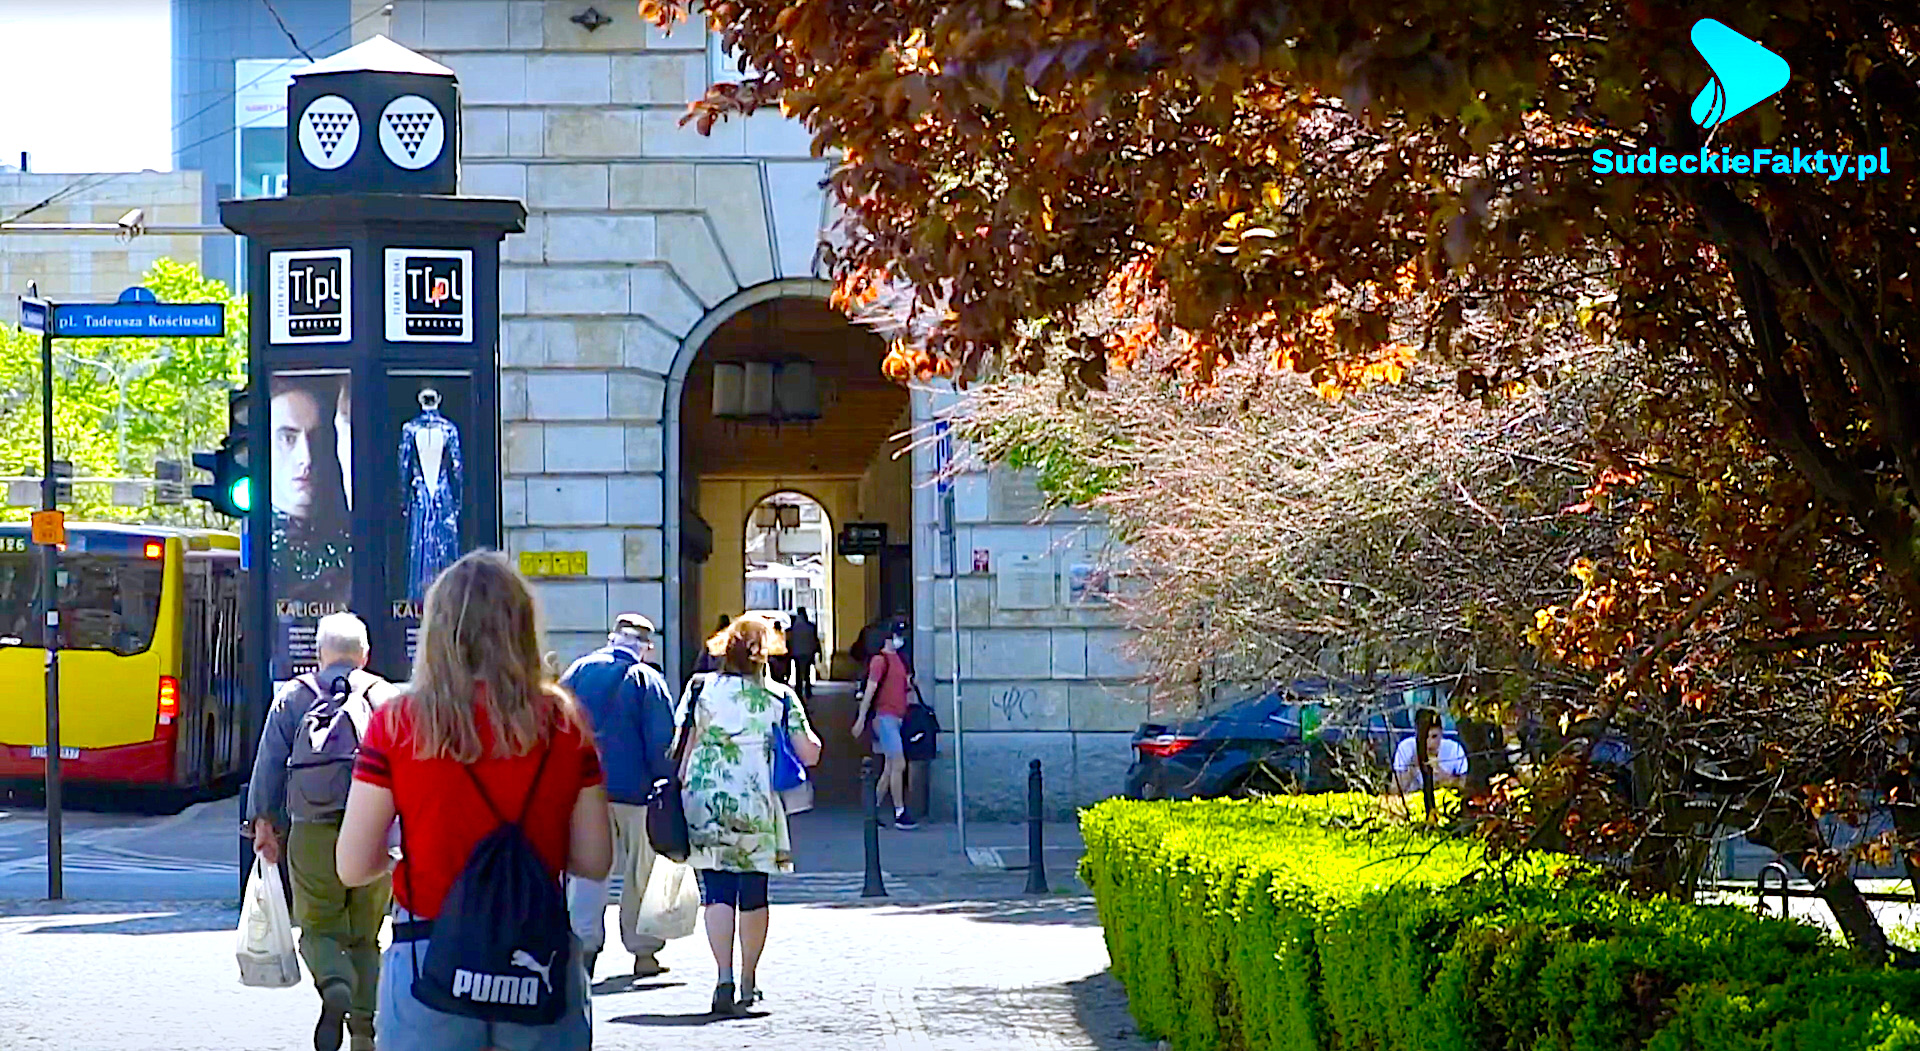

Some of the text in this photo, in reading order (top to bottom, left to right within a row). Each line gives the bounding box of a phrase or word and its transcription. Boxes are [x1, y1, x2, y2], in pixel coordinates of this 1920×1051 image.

[58, 315, 78, 329] pl.
[83, 314, 142, 328] Tadeusza
[148, 314, 217, 328] Kościuszki
[452, 968, 539, 1006] PUMA
